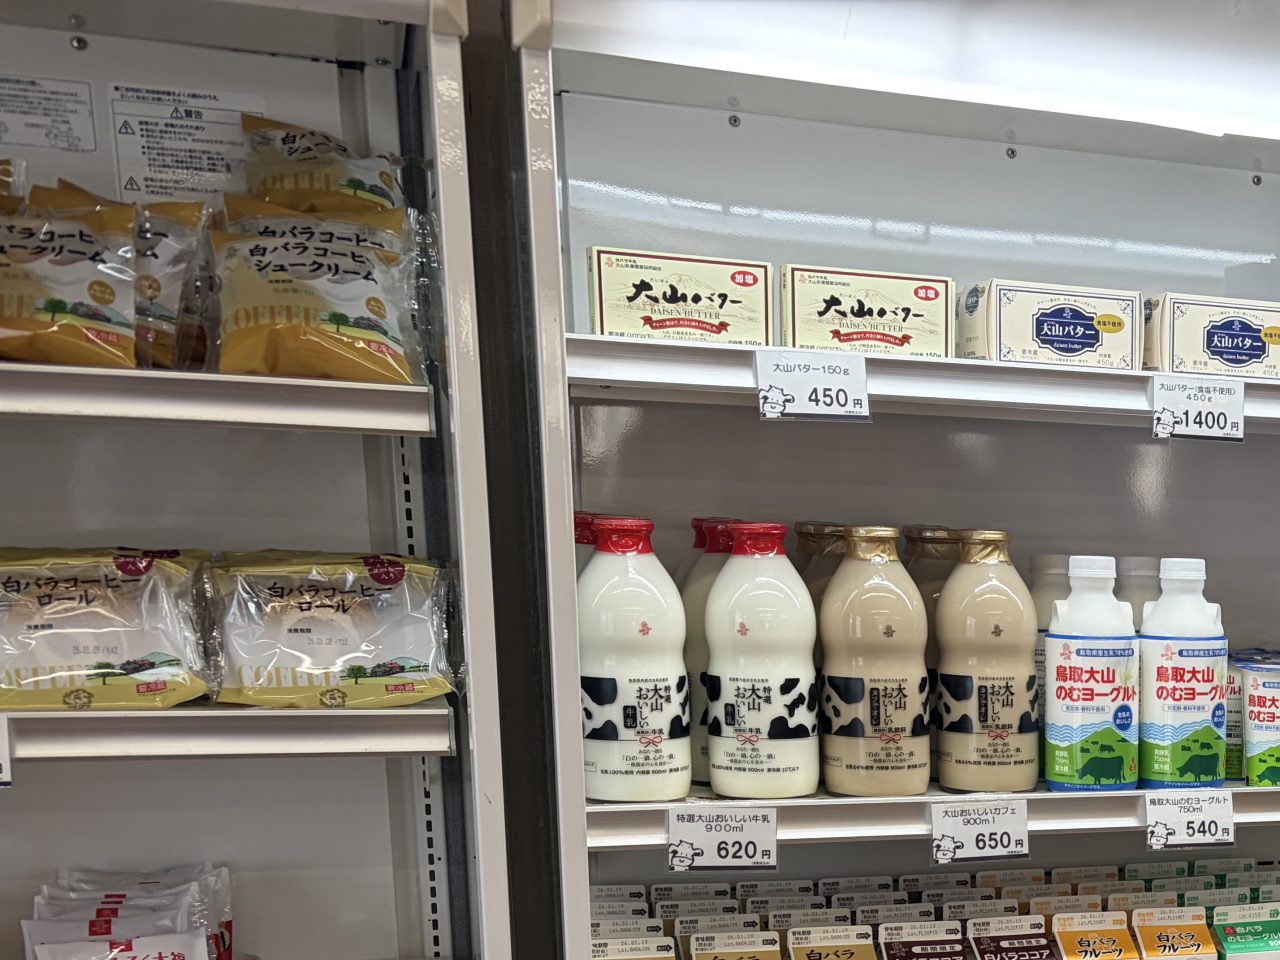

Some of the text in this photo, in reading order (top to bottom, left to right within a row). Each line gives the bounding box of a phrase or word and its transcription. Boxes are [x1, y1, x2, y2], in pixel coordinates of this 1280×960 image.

[254, 258, 378, 285] シュークリーム
[626, 278, 743, 309] 大山バター
[651, 306, 720, 320] DAISEN BUTTER
[817, 294, 925, 322] 大山バター
[839, 321, 868, 331] DAISEN
[2, 575, 140, 594] 白バラコーヒー
[268, 582, 392, 600] 白バラコーヒー
[37, 591, 96, 606] ロール
[299, 600, 352, 614] ロール
[1056, 665, 1116, 684] 鳥取大山
[1156, 665, 1215, 684] 鳥取大山
[650, 684, 664, 712] 大山
[747, 685, 762, 712] 大山
[1056, 686, 1137, 703] のむヨーグルト
[636, 686, 650, 728] おいしい
[1149, 796, 1228, 807] 鳥取大山のむヨーグルト
[676, 813, 770, 825] 特選大山おいしい牛乳
[942, 806, 1017, 818] 大山おいしいカフェ
